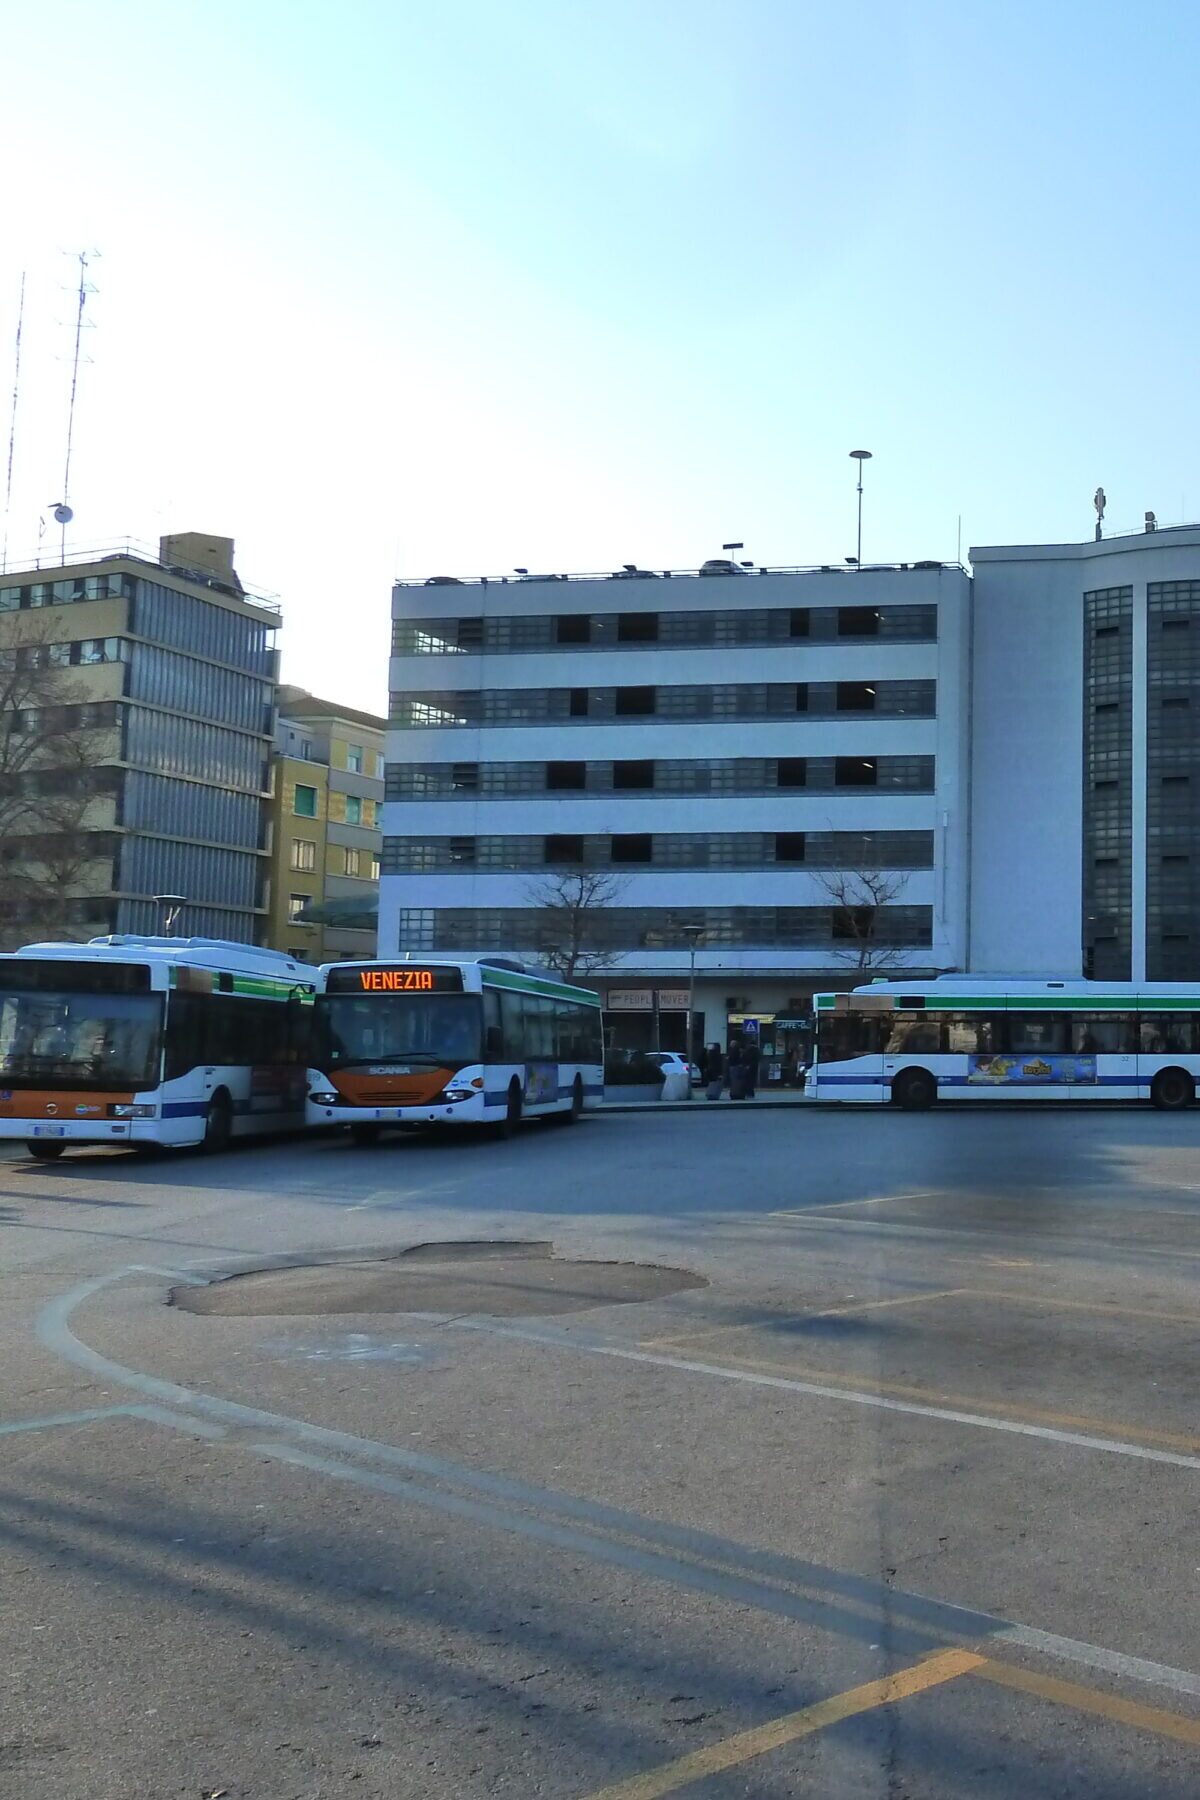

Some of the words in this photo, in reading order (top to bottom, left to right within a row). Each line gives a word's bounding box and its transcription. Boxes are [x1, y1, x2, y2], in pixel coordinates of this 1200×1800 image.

[360, 971, 433, 990] VENEZIA
[624, 994, 653, 1005] PEOPL
[660, 994, 689, 1005] MOVER
[369, 1066, 411, 1075] SCANIA
